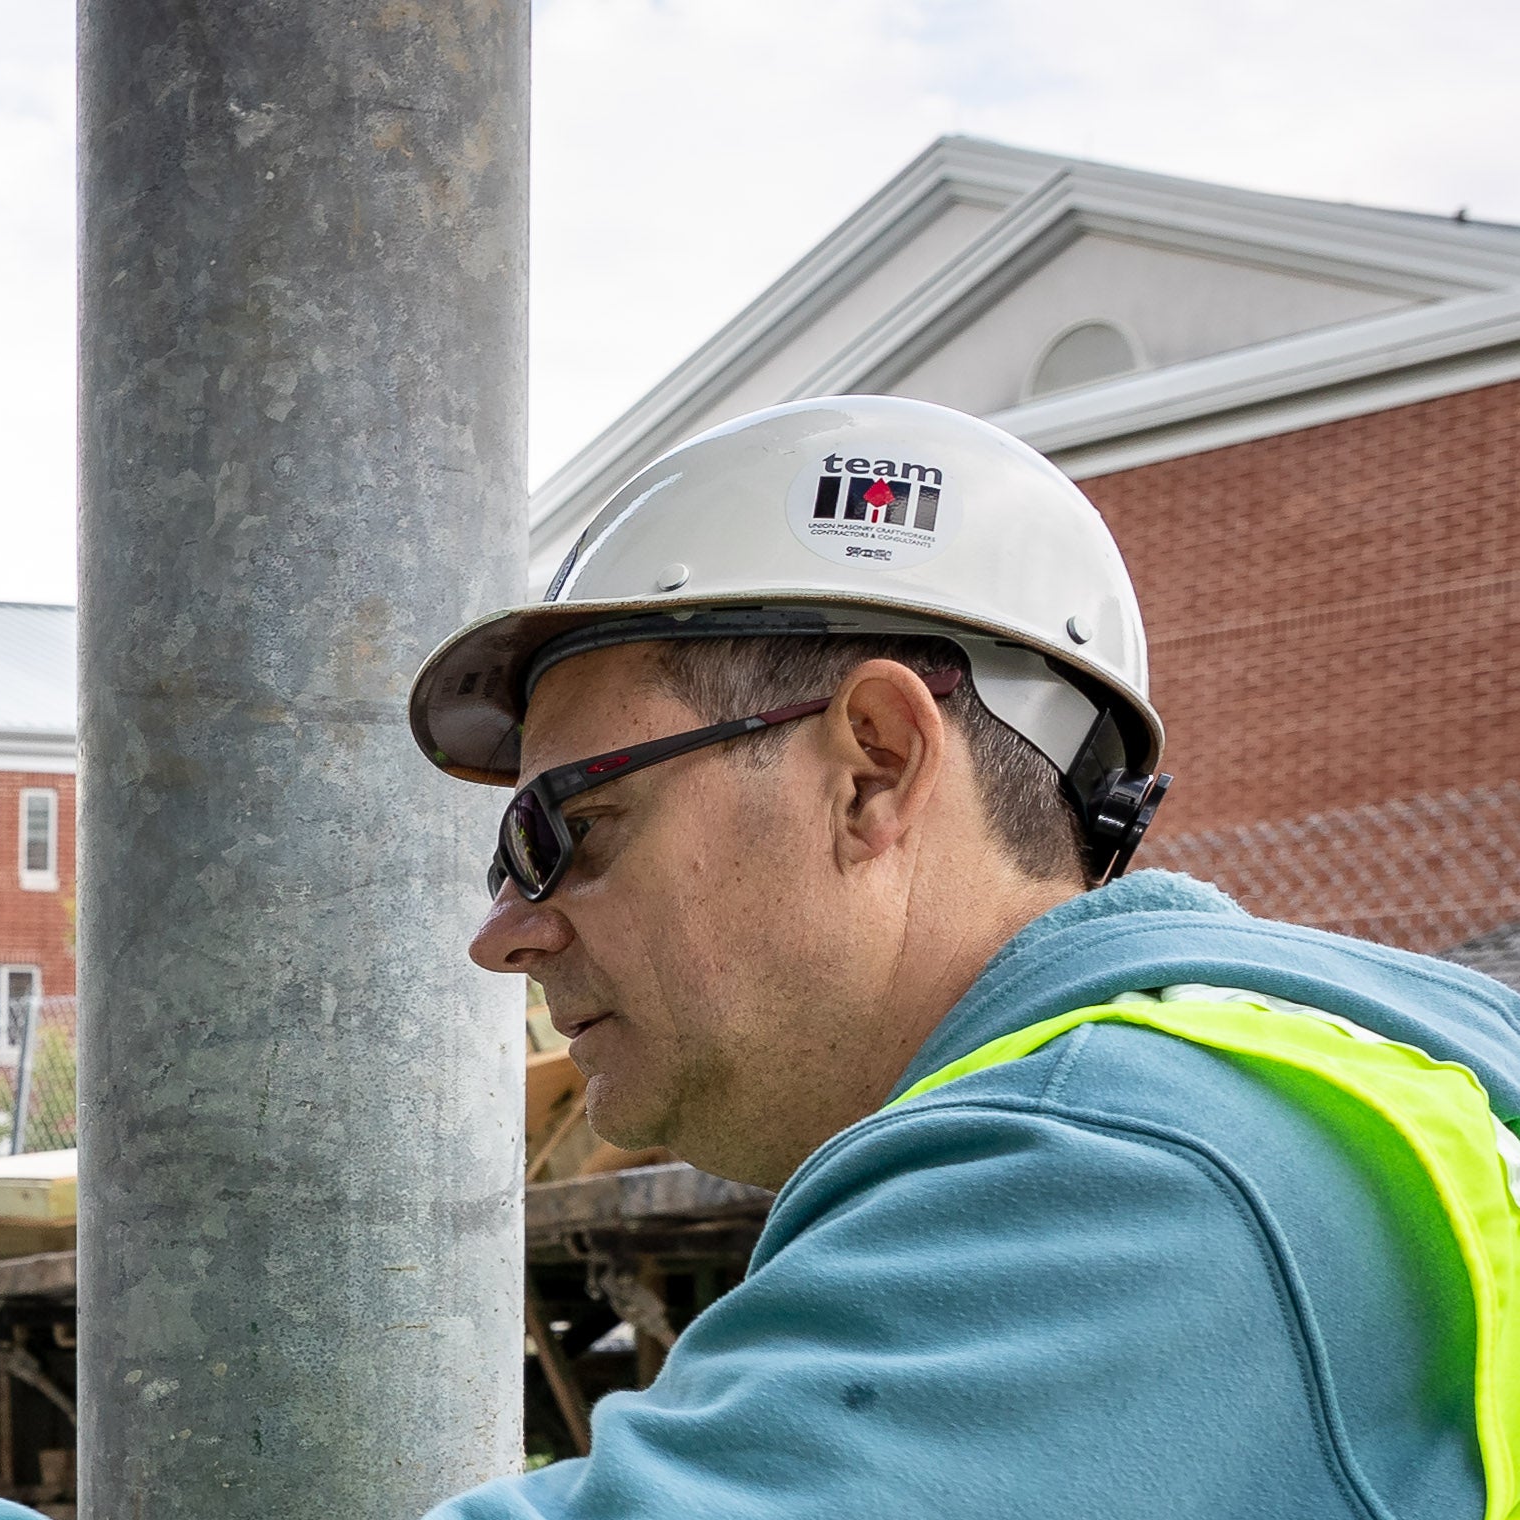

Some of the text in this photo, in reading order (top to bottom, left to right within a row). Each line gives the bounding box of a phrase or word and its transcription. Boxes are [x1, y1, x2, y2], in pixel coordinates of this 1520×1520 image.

[822, 453, 943, 485] team
[810, 529, 869, 539] CONTRACTORS
[878, 534, 932, 548] CONSULTANTS
[836, 524, 874, 532] MASONRY
[876, 526, 936, 543] CRAFTWORKERS
